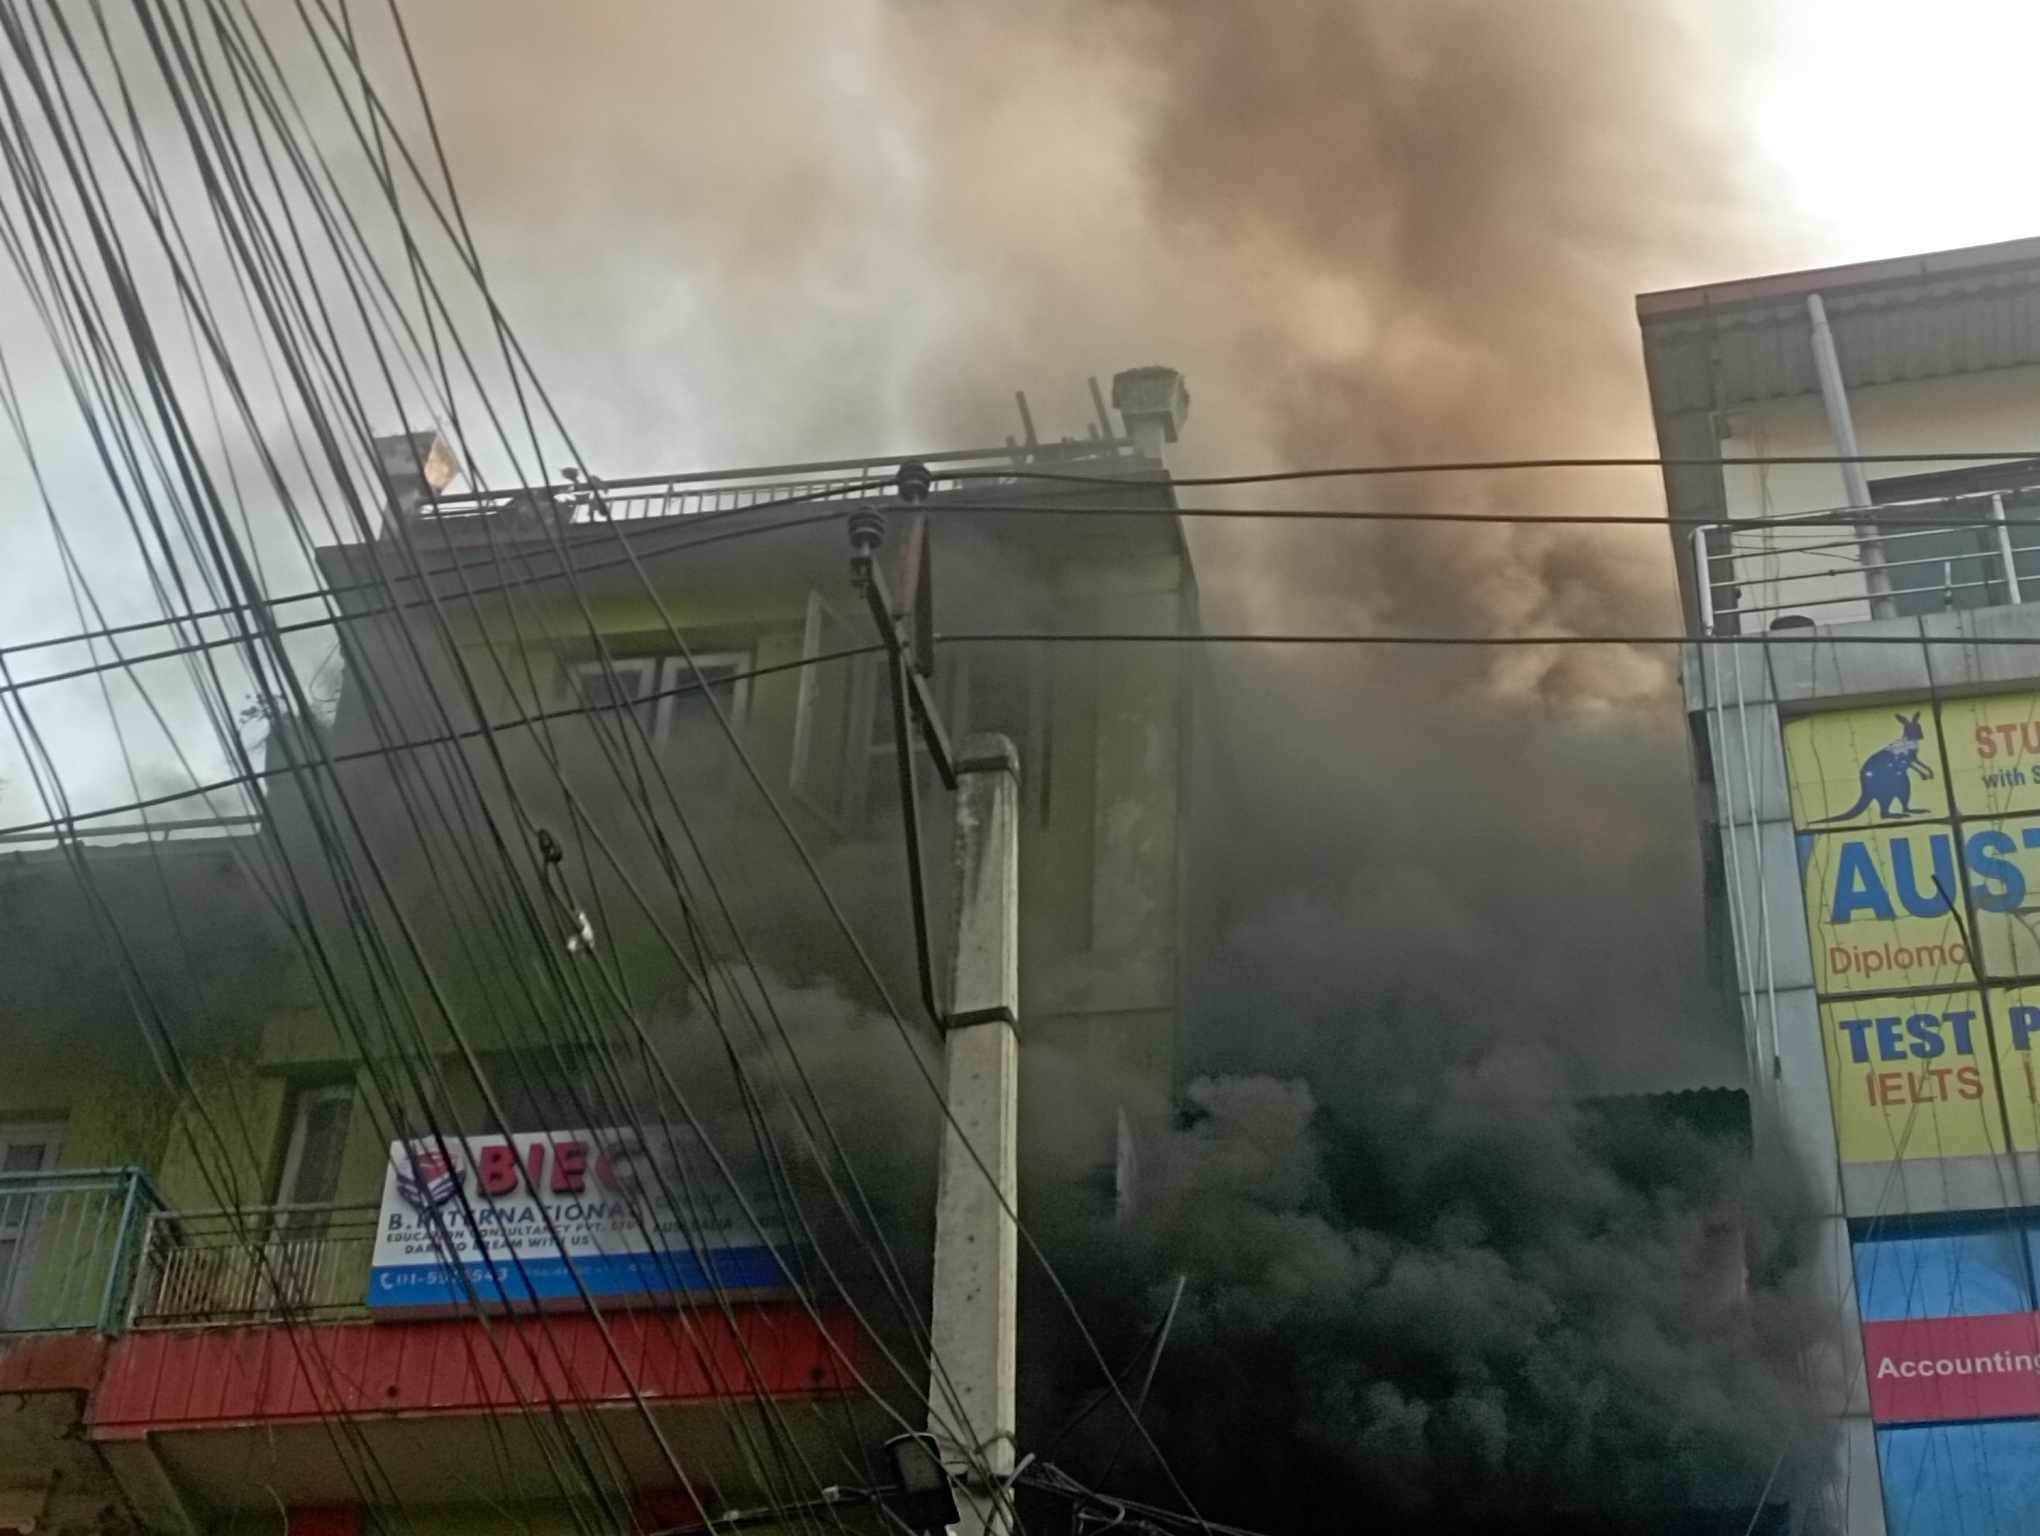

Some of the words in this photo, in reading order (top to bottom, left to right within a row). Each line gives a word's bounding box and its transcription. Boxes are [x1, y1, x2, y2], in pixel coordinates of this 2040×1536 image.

[1982, 767, 2025, 789] with
[1830, 943, 1971, 978] Diploma
[1839, 1010, 1976, 1063] TEST
[2009, 1005, 2040, 1051] P
[1866, 1066, 1983, 1106] IELTS
[478, 1140, 645, 1196] BIEC
[387, 1230, 465, 1243] EDUCAON
[472, 1223, 570, 1239] ONULTACY
[405, 1240, 448, 1254] DAR
[571, 1235, 590, 1246] US
